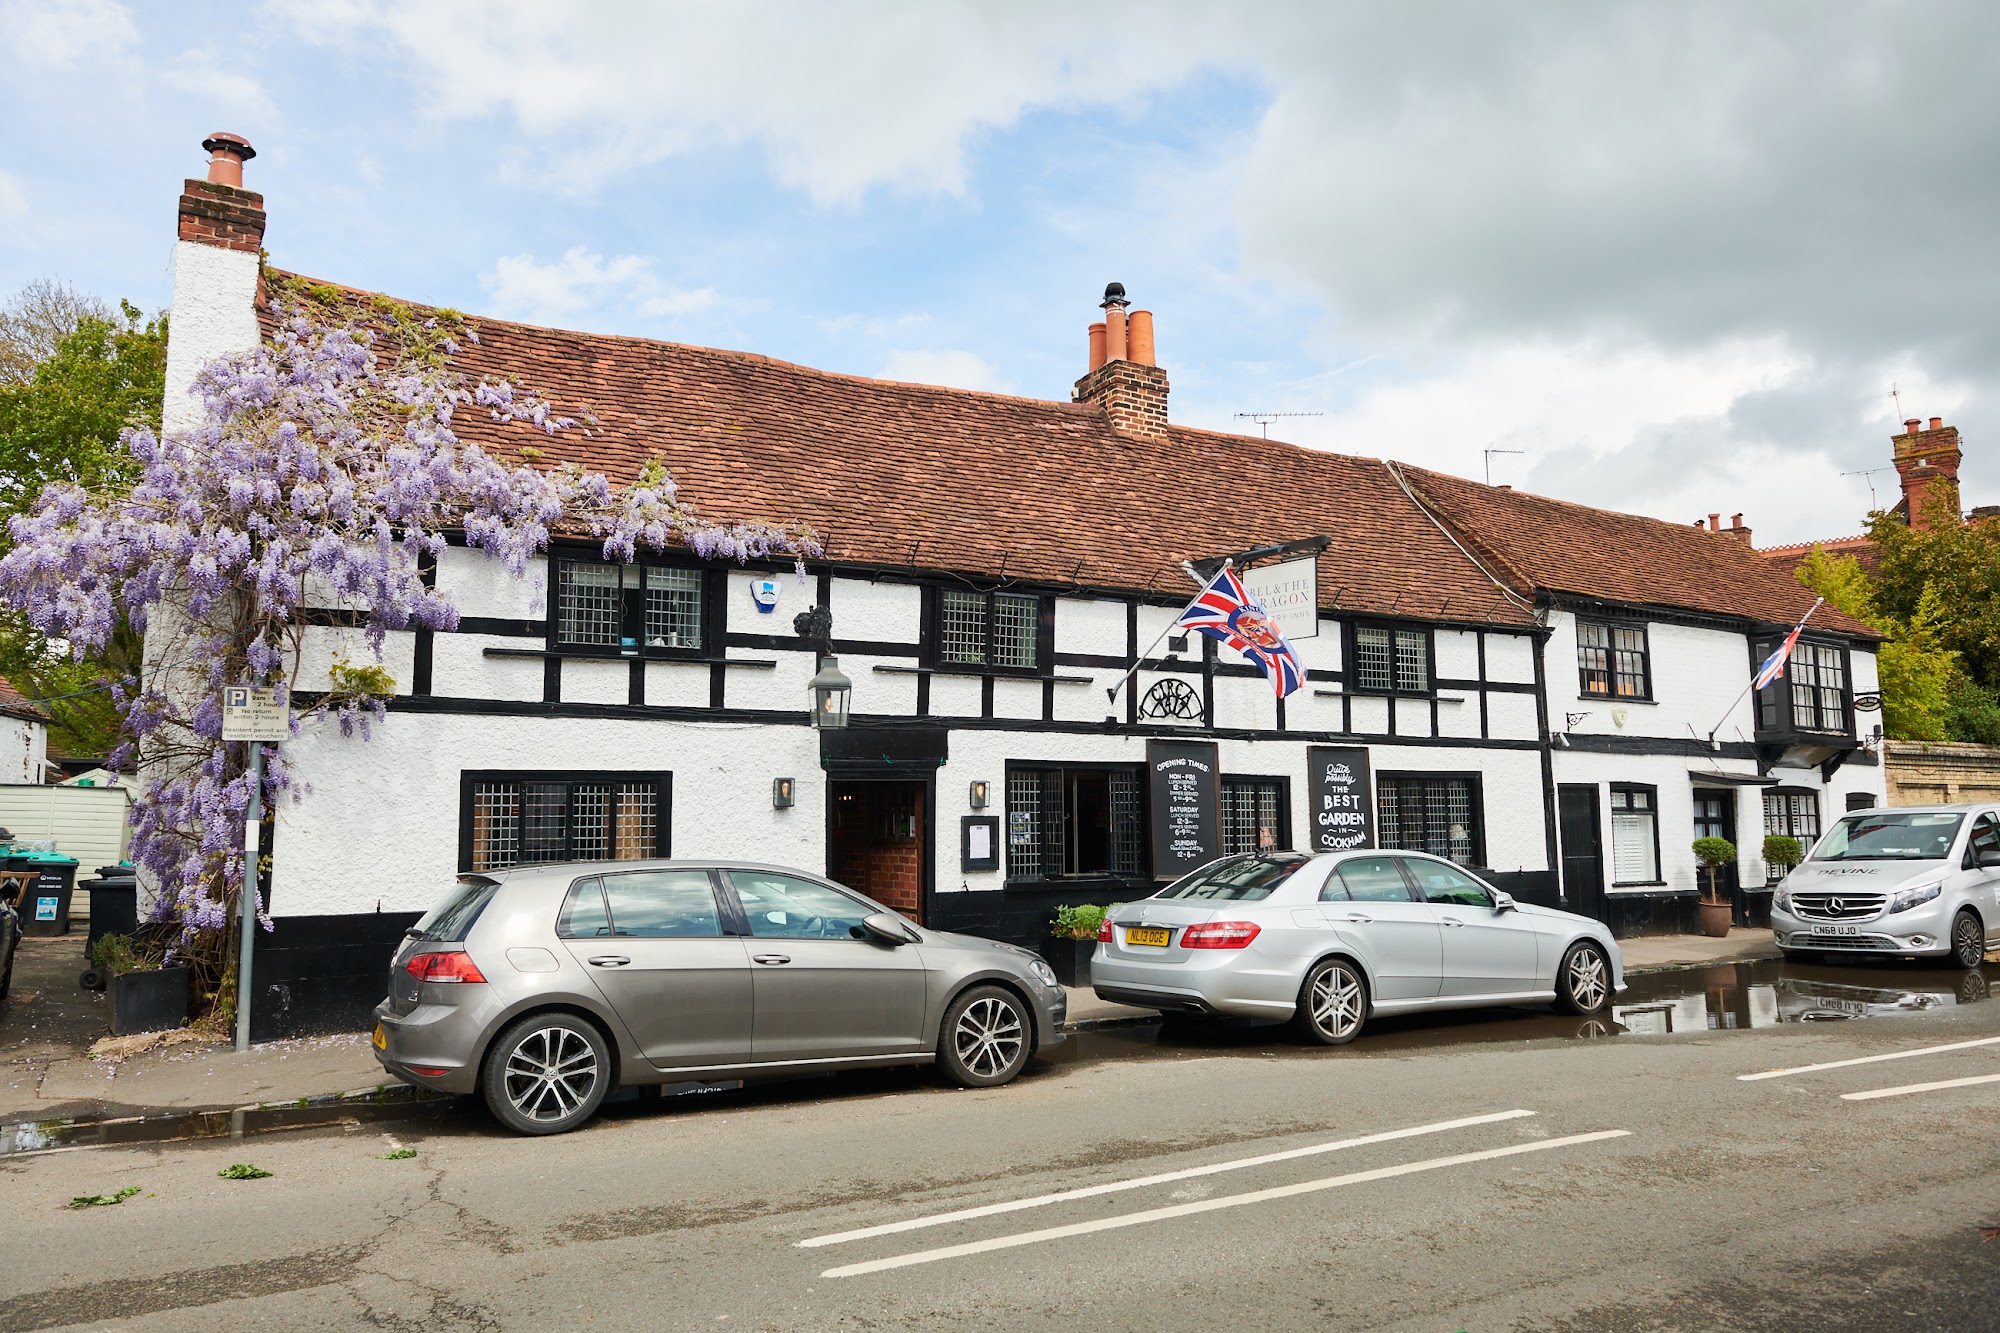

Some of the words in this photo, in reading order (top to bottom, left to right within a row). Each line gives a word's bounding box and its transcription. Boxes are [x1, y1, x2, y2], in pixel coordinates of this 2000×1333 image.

[1260, 591, 1309, 609] RAGON
[1290, 610, 1310, 618] INNS
[231, 690, 244, 706] P
[1152, 681, 1194, 704] CIRCA
[1156, 758, 1186, 772] OPENING
[1326, 763, 1351, 775] Quite
[1324, 774, 1356, 785] possibly
[1324, 795, 1360, 810] BEST
[1318, 812, 1365, 825] GARDEN
[1321, 831, 1366, 848] COOKHAM
[1130, 930, 1148, 942] NL13
[1149, 931, 1165, 943] OGE
[1814, 926, 1836, 934] CN68
[1838, 926, 1856, 934] UJO
